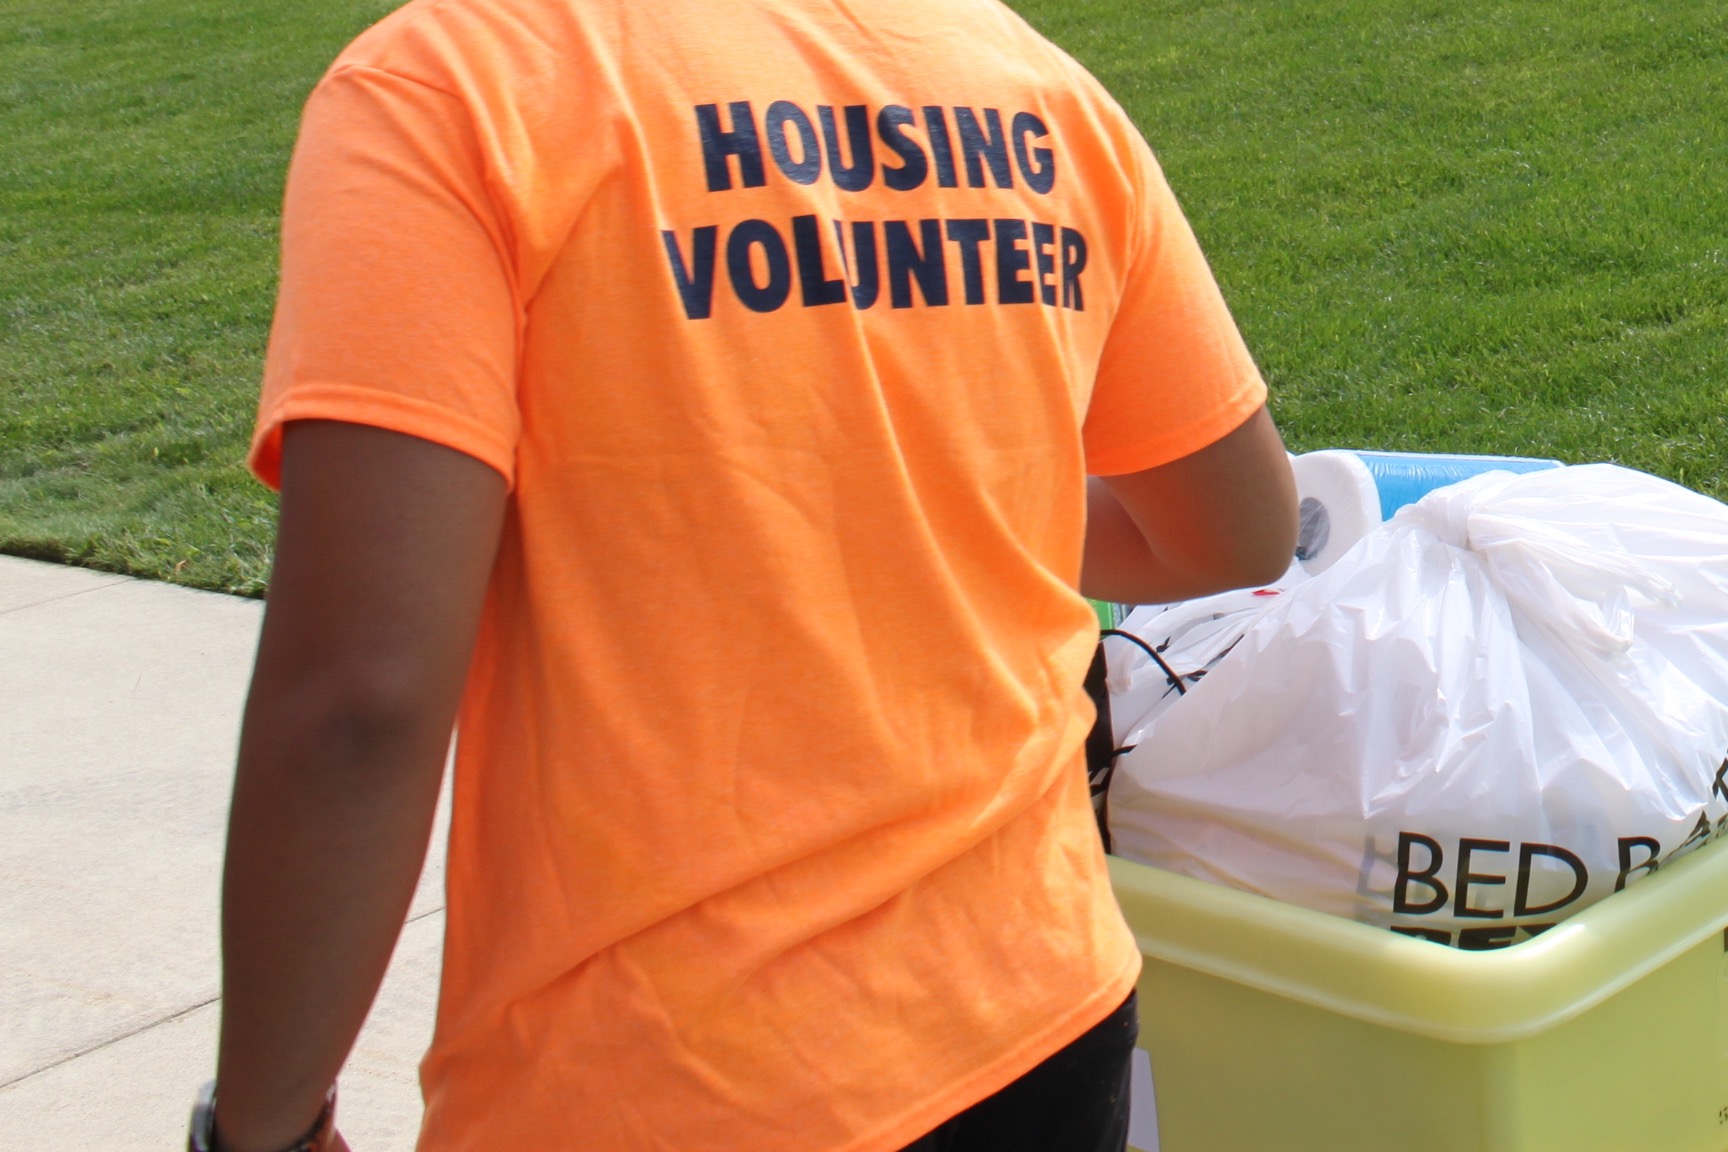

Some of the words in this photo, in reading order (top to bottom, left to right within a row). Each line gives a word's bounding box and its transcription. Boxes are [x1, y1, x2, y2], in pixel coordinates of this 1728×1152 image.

[694, 100, 1057, 195] HOUSING
[662, 213, 1089, 321] VOLUNTEER
[1392, 830, 1589, 920] BED
